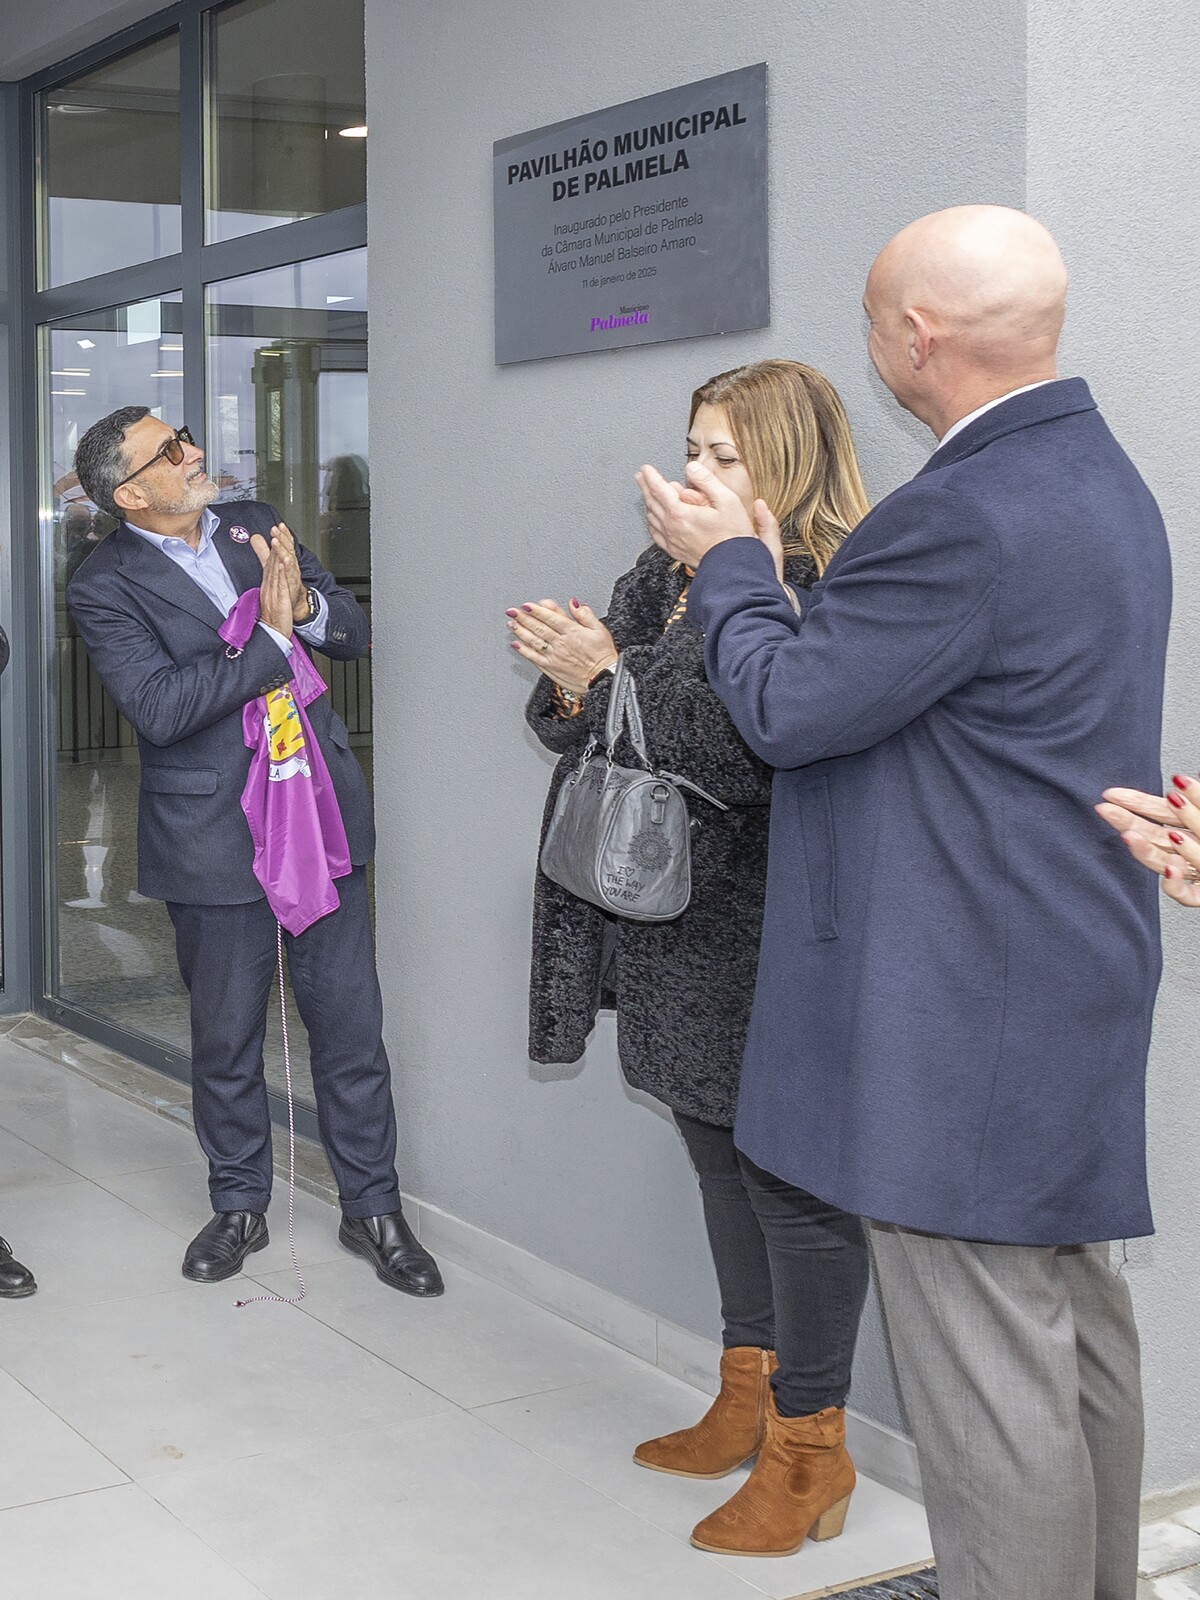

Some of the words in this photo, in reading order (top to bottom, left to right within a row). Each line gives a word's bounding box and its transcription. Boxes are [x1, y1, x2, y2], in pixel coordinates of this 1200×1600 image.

[507, 138, 608, 185] PAVILHÃO
[614, 103, 747, 157] MUNICIPAL
[553, 178, 580, 202] DE
[585, 149, 690, 194] PALMELA
[541, 243, 554, 258] da
[555, 235, 592, 256] Câmara
[594, 228, 643, 249] Municipal
[645, 220, 659, 235] de
[661, 212, 704, 233] Palmela
[554, 214, 607, 236] Inaugurado
[609, 208, 631, 226] pelo
[634, 195, 689, 218] Presidente
[547, 255, 577, 274] Álvaro
[579, 250, 615, 268] Manuel
[618, 243, 658, 261] Balseiro
[660, 235, 696, 252] Amaro
[590, 276, 599, 288] de
[600, 271, 625, 288] janeiro
[626, 270, 636, 281] de
[637, 266, 657, 279] 2025
[590, 310, 650, 332] Palmela
[602, 885, 621, 897] YOU
[620, 889, 641, 903] ARE
[606, 873, 625, 886] THE
[625, 878, 646, 892] WAY
